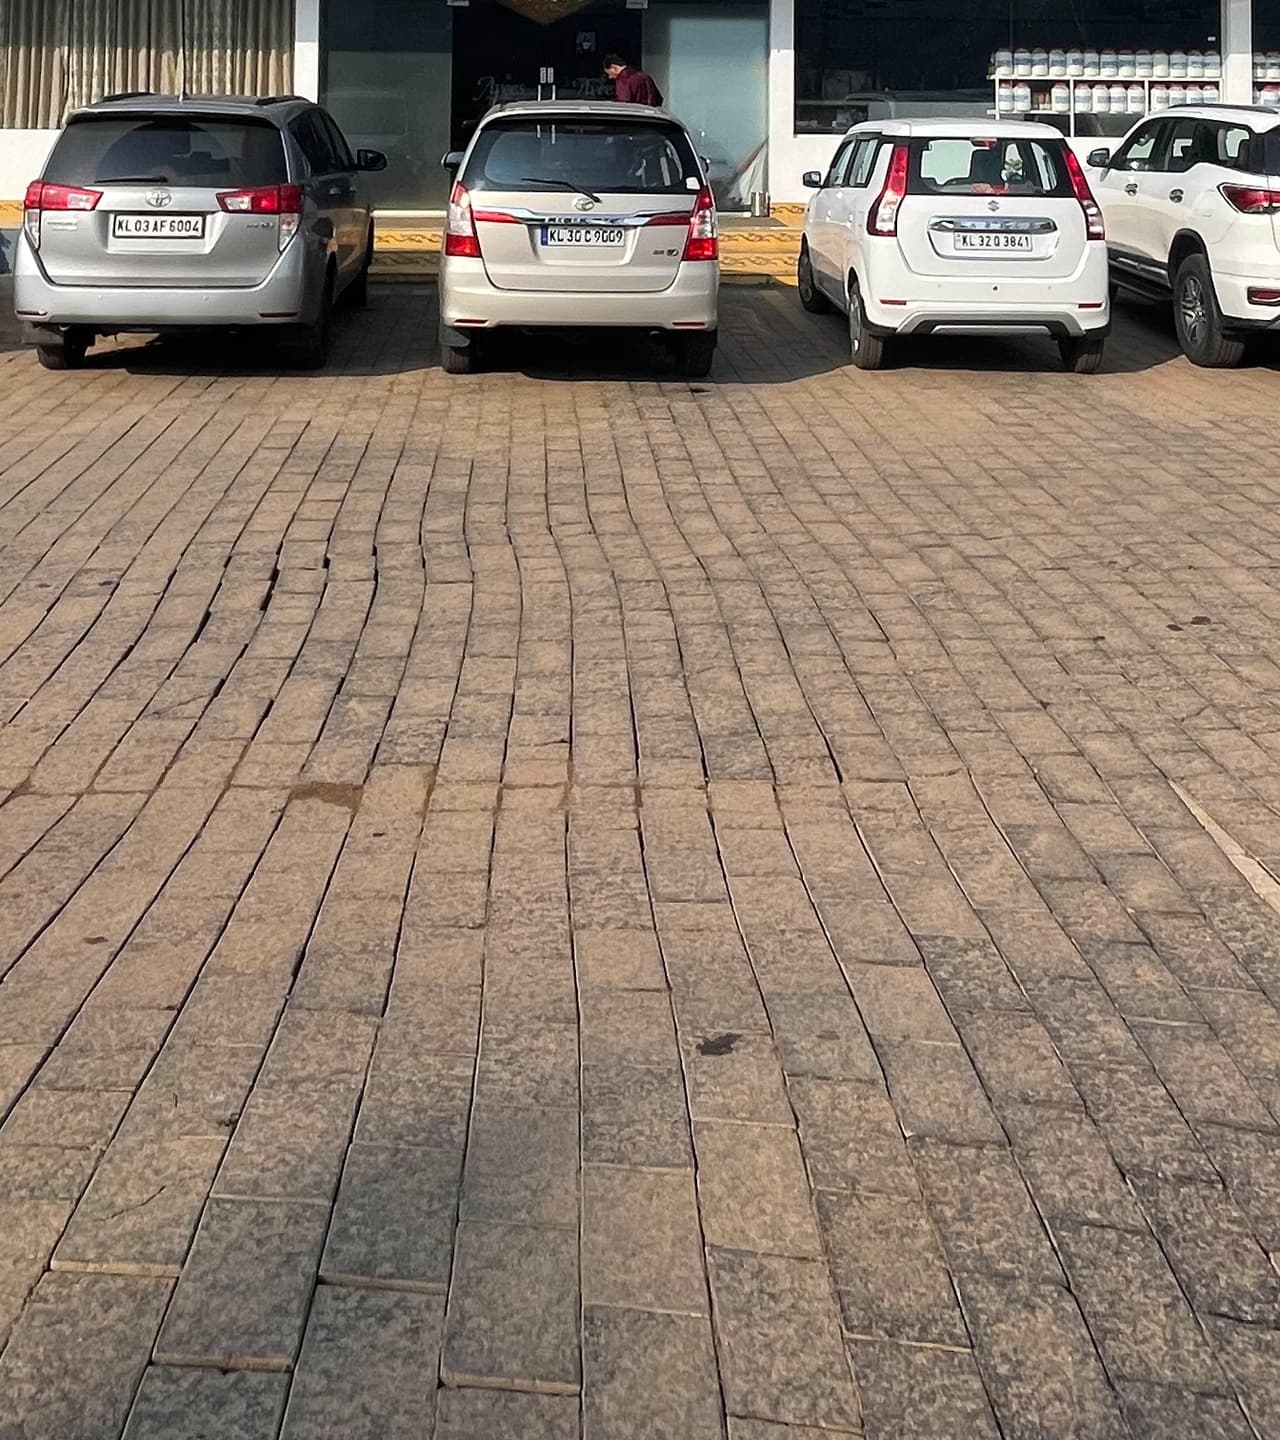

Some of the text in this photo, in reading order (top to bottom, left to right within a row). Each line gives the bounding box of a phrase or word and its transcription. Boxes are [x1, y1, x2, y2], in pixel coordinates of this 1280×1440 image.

[117, 220, 199, 232] KL 03 AF 6004
[550, 230, 563, 242] KL
[567, 230, 581, 242] 30
[594, 230, 623, 243] 9009
[962, 235, 975, 246] KL
[978, 236, 991, 246] 32
[1003, 236, 1029, 247] 3841
